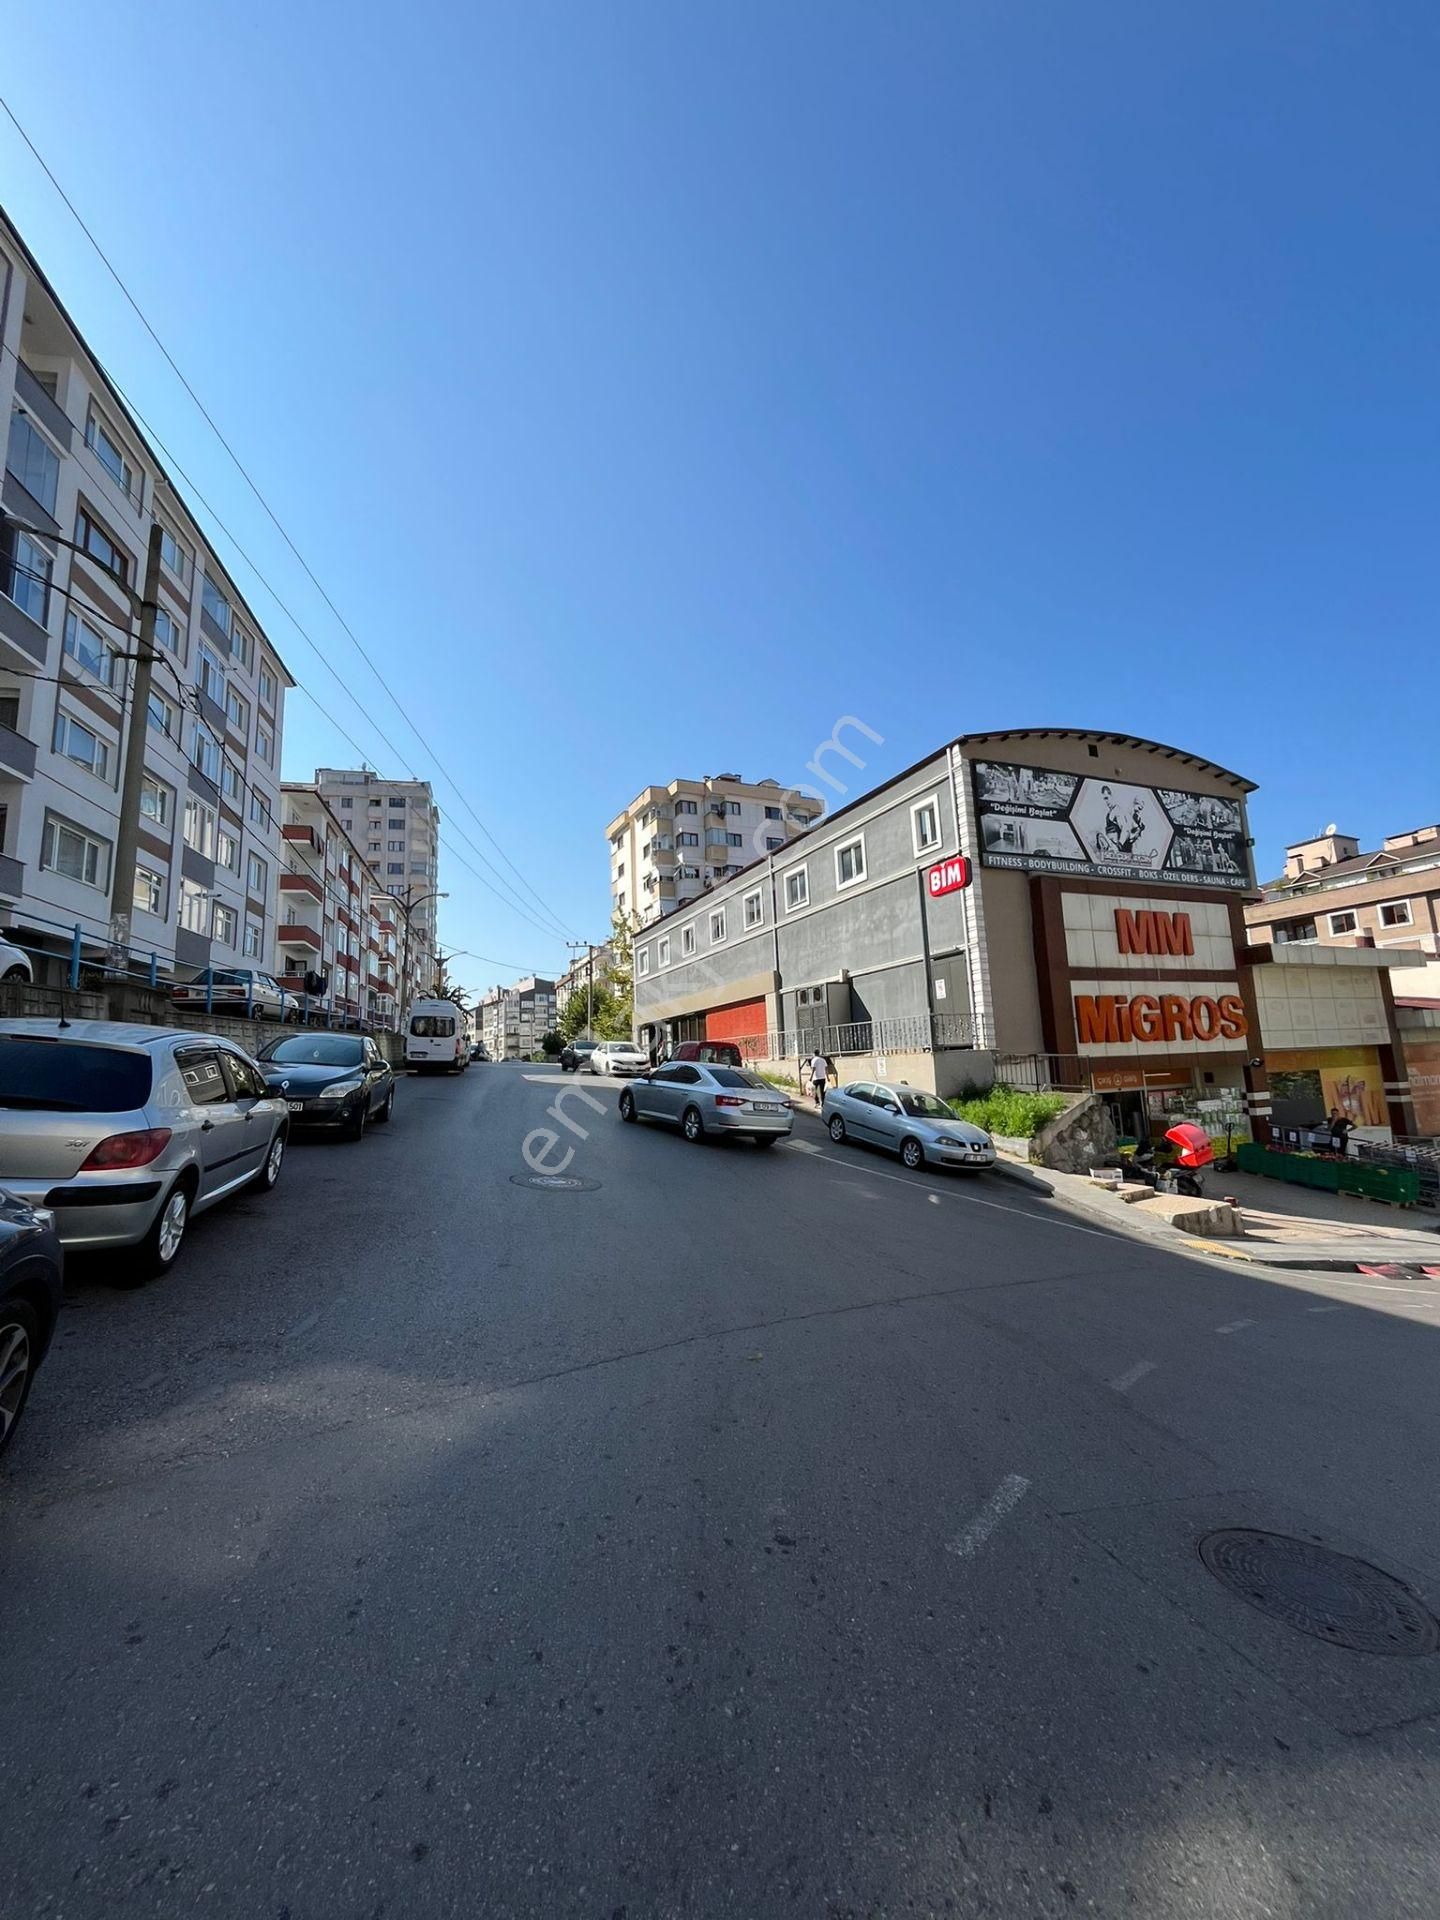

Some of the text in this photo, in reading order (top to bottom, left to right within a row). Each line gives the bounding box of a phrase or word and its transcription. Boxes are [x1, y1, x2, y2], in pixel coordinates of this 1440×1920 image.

[988, 855, 1246, 887] FITNESS BODYBUILDING CROSSFIT BOKS ÖZEL DERS SAUNA CAFE
[1114, 908, 1195, 956] MM
